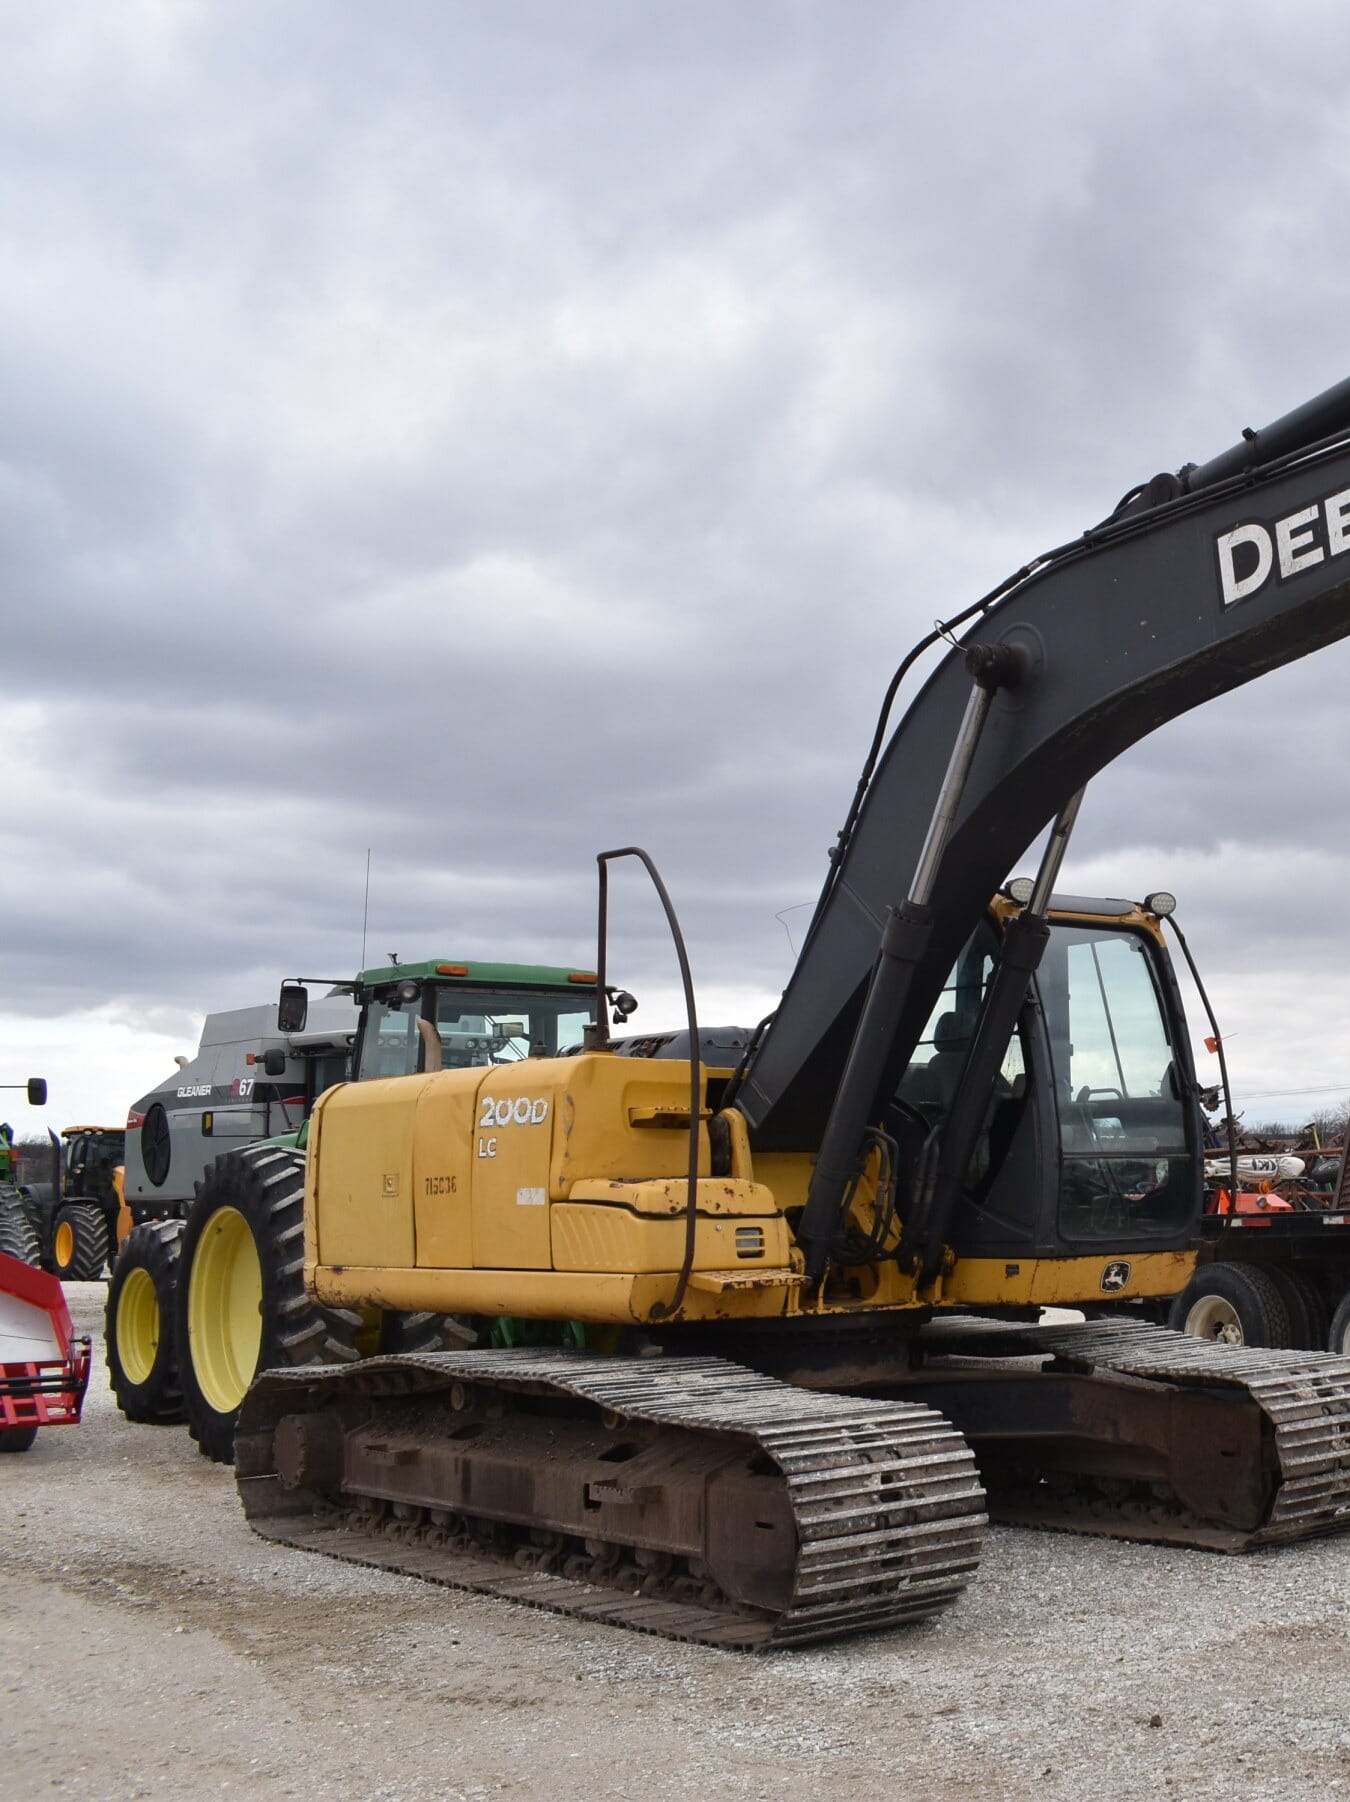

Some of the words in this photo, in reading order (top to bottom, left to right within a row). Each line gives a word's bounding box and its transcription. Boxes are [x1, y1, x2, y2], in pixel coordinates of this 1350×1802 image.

[177, 1084, 211, 1098] GLEANER
[479, 1096, 548, 1127] 200D
[478, 1137, 497, 1158] LC
